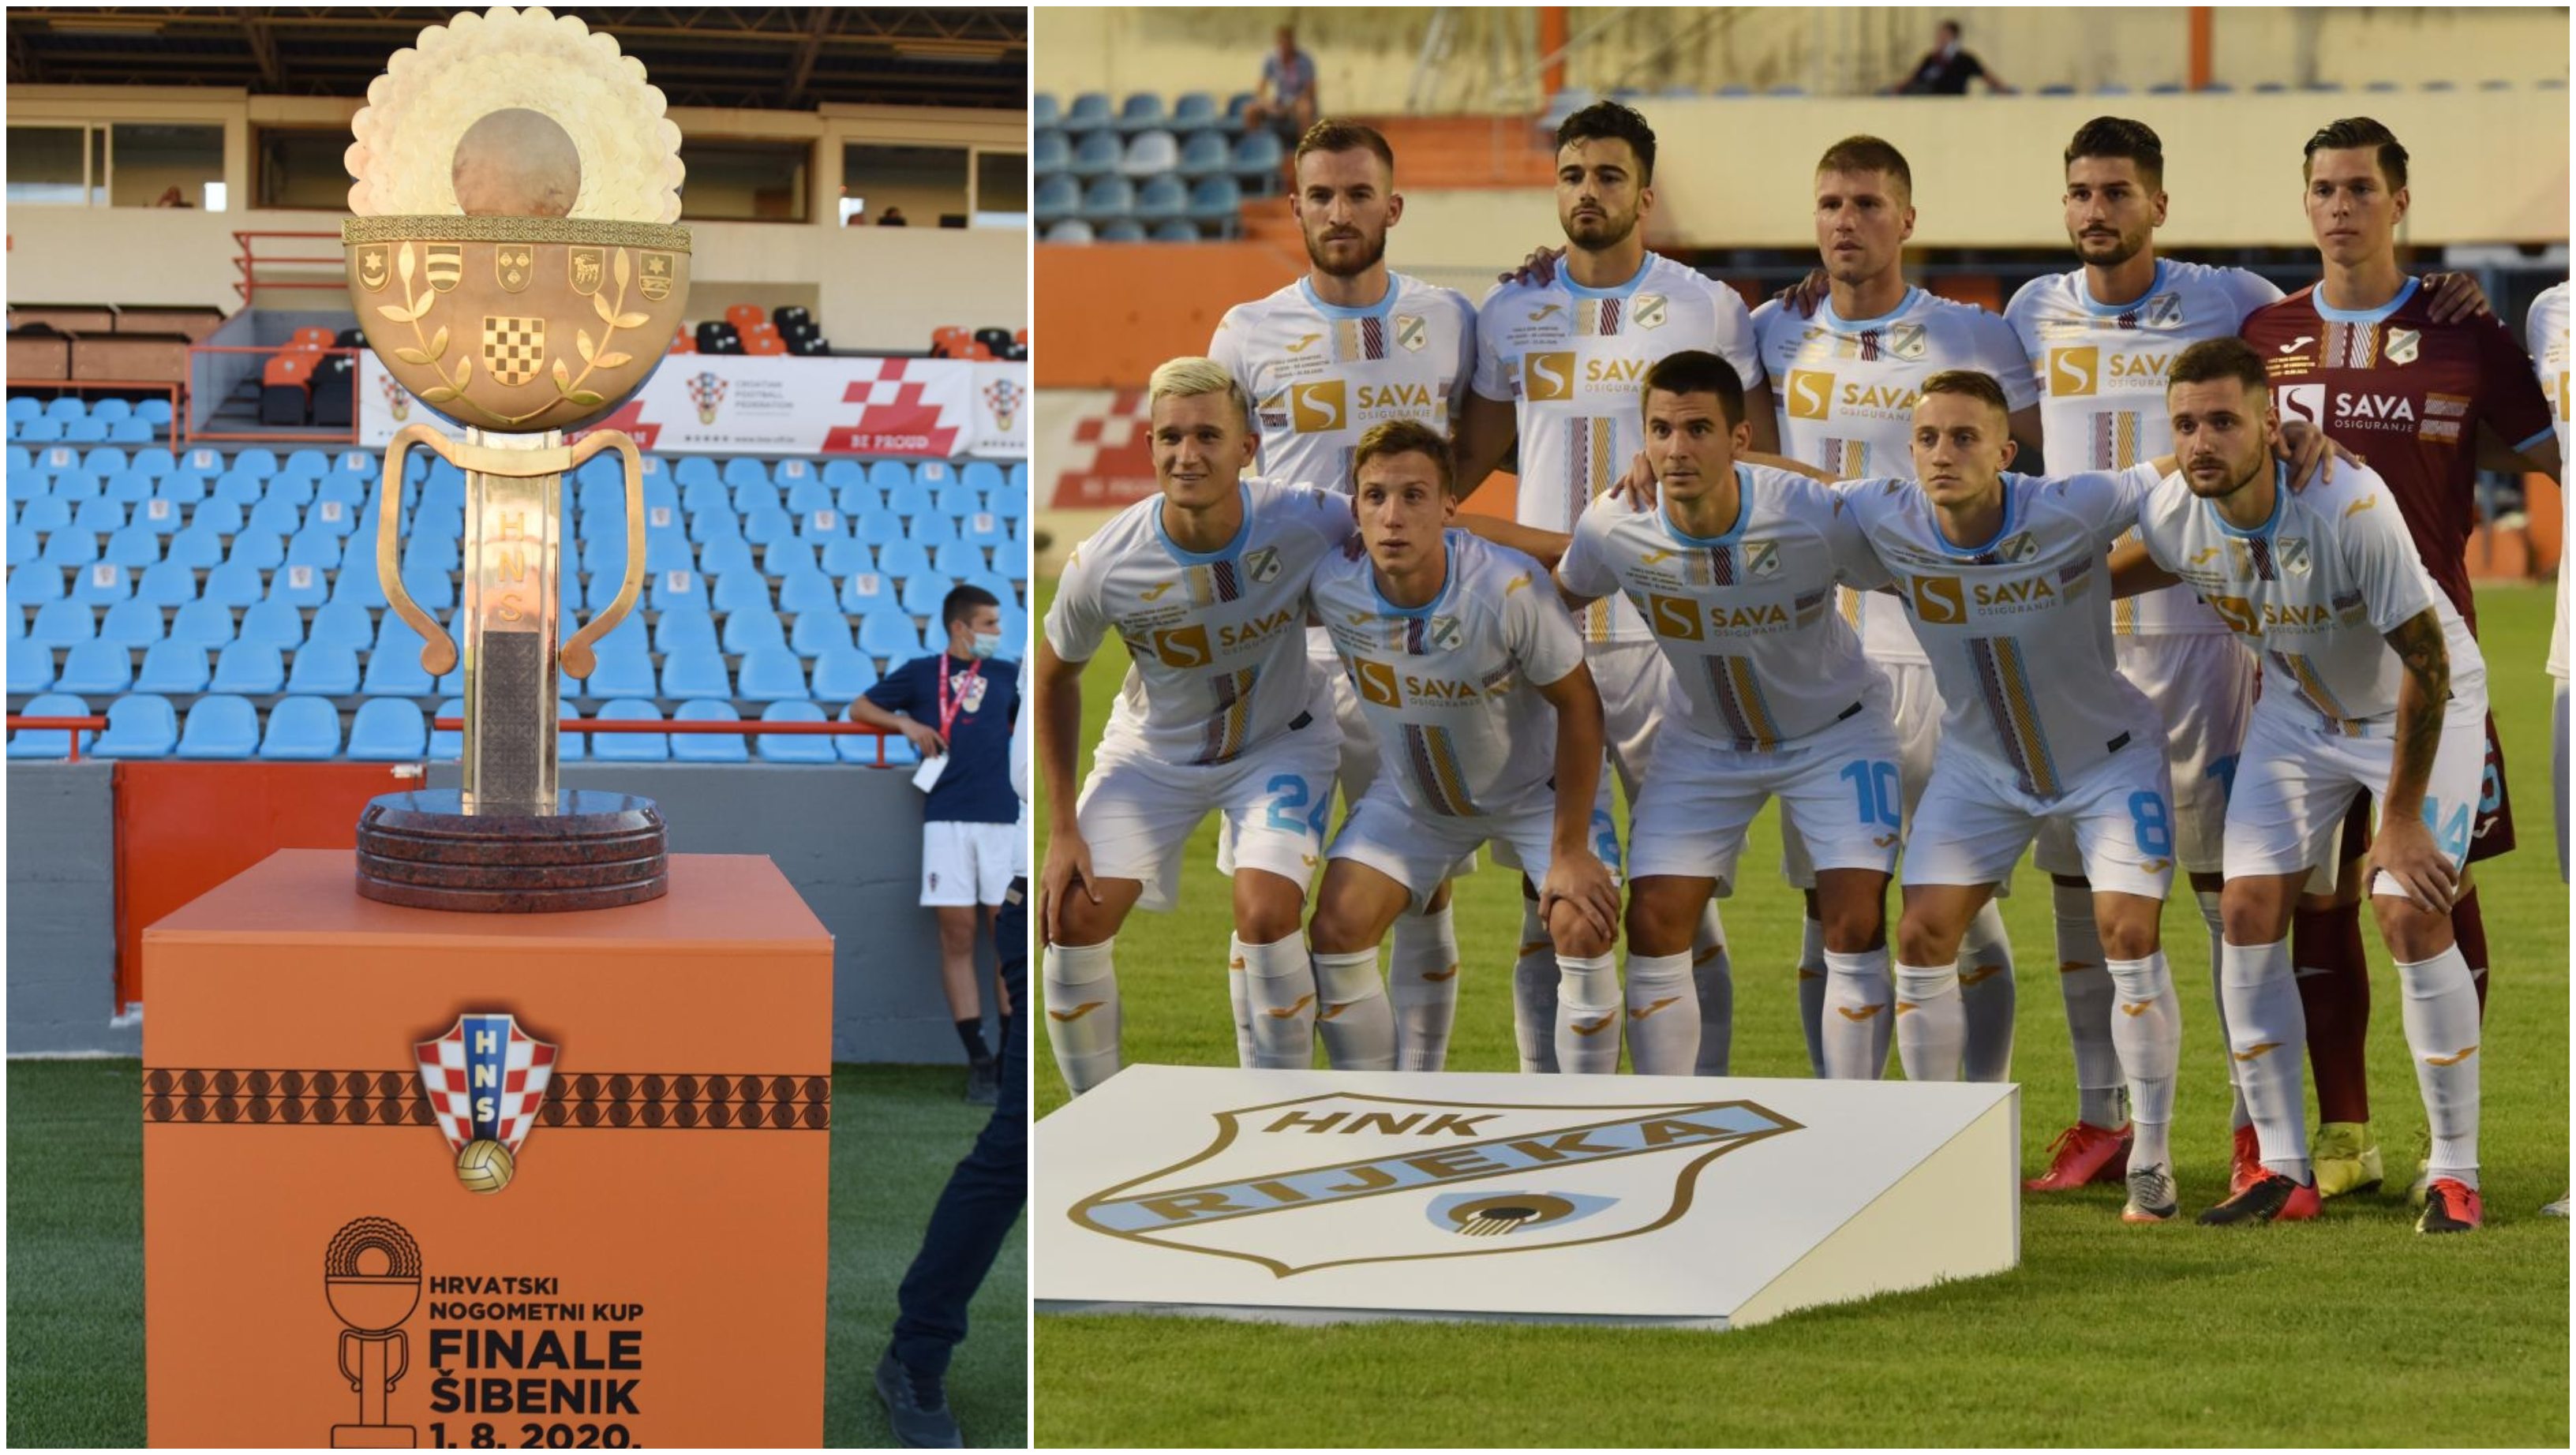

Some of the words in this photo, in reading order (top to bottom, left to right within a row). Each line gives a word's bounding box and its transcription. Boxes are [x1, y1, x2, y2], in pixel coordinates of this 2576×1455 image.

[1357, 382, 1432, 410] SAVA
[2334, 393, 2415, 421] SAVA
[2334, 420, 2415, 433] OSIGURANJE
[874, 435, 929, 450] PROUD
[499, 511, 524, 621] HNS
[1974, 577, 2054, 605] SAVA
[1219, 610, 1293, 647] SAVA
[1710, 604, 1789, 628] SAVA
[2262, 604, 2332, 625] SAVA
[1406, 676, 1477, 699] SAVA
[1840, 760, 1901, 827] 10
[2128, 791, 2171, 856] 8
[474, 1030, 496, 1122] HNS
[1262, 1111, 1507, 1136] HNK
[1136, 1119, 1739, 1221] RIJEKA
[430, 1276, 558, 1295] HRVATSKI
[430, 1302, 585, 1321] NOGOMETNI
[593, 1304, 643, 1322] KUP
[429, 1329, 642, 1370] FINALE
[429, 1368, 640, 1414] ŠIBENIK
[429, 1422, 457, 1449] 1.
[470, 1423, 506, 1449] 8.
[520, 1423, 642, 1449] 2020.
